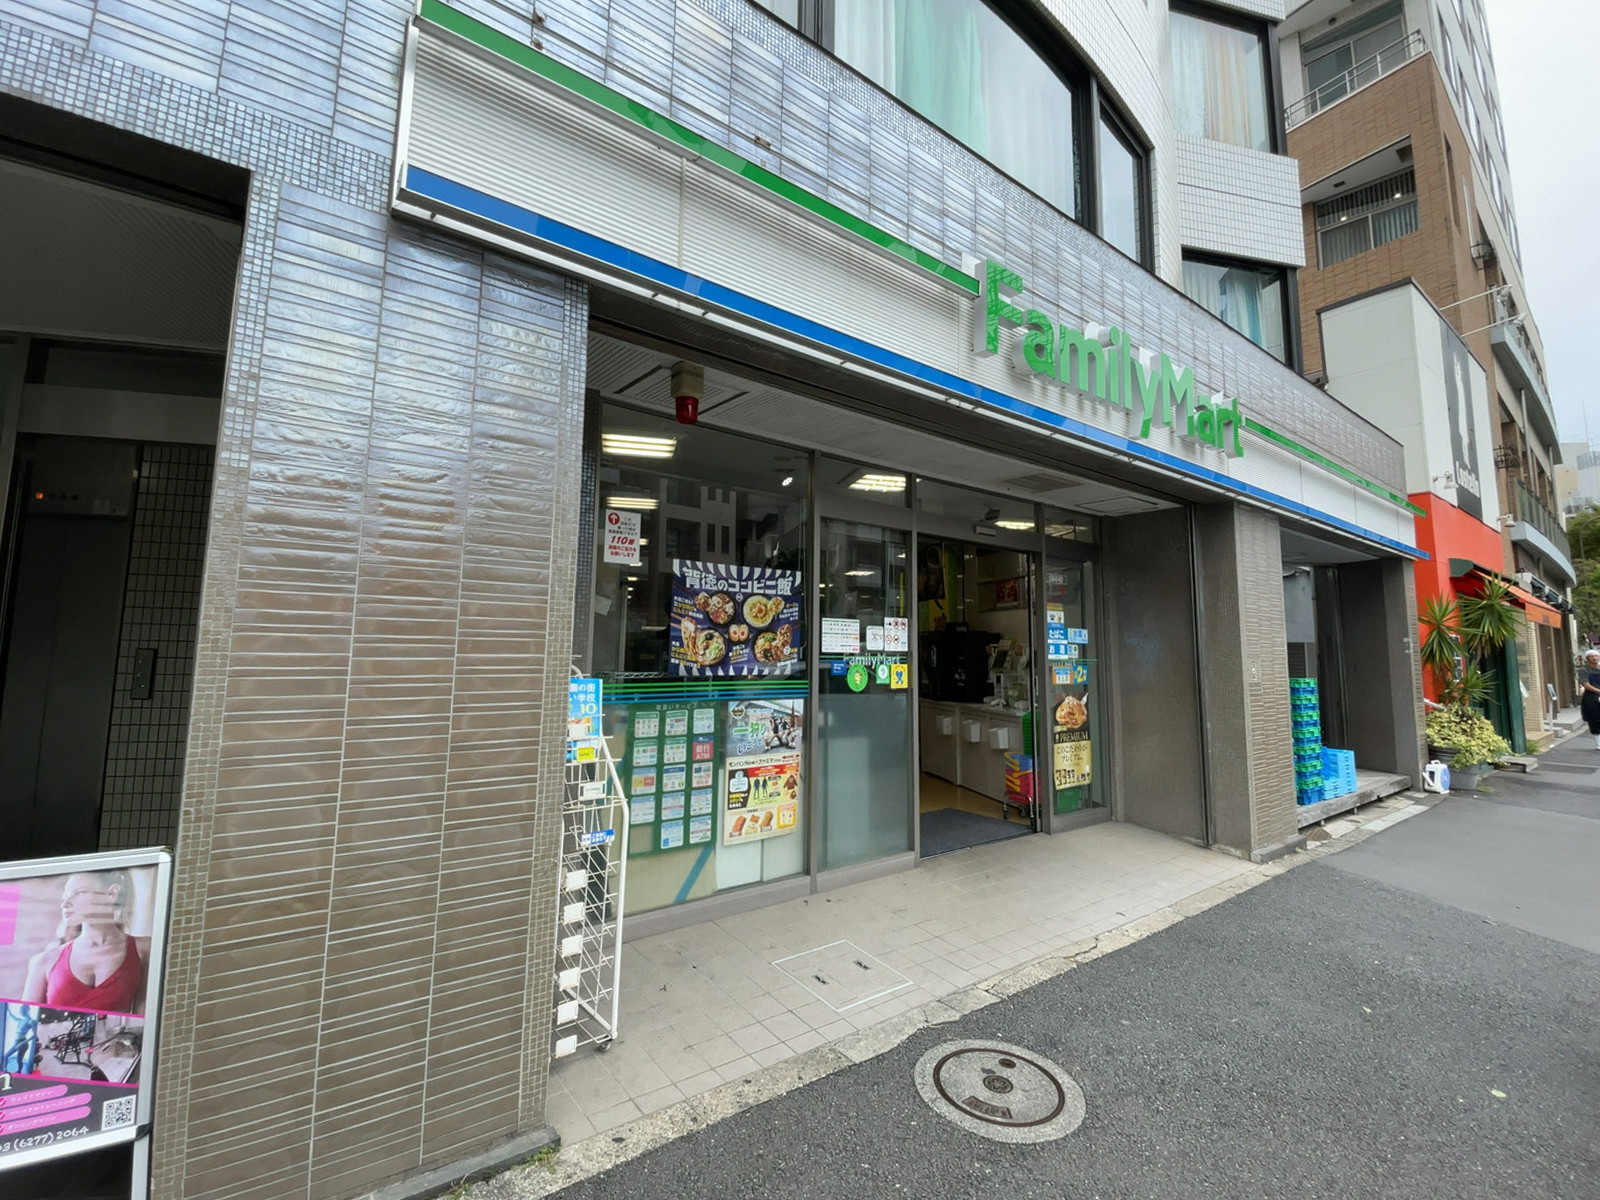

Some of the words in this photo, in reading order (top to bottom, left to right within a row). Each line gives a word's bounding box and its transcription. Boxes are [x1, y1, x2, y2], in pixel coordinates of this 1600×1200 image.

[976, 258, 1244, 459] FamilyMart
[682, 567, 793, 596] 背徳のコンビニ飯
[843, 652, 901, 669] FamilyMart
[733, 722, 767, 739] 一狩り
[1060, 731, 1089, 743] PREMIUM
[13, 1132, 55, 1152] (6277)
[56, 1126, 89, 1140] 2064
